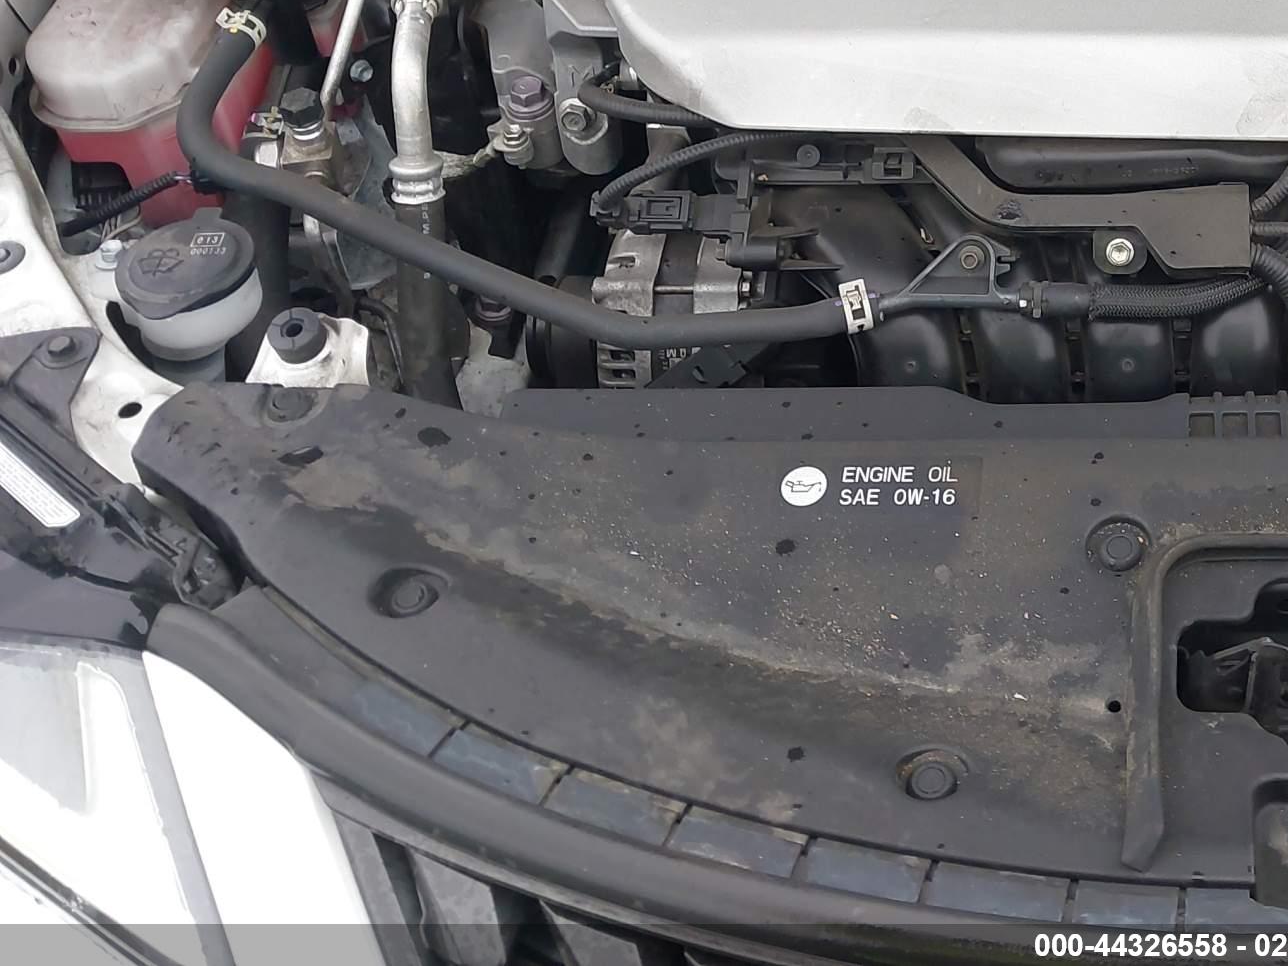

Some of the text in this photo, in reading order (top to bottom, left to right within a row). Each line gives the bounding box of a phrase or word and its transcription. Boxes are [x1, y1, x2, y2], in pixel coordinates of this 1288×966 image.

[842, 466, 958, 482] ENGINE OIL
[839, 488, 956, 506] SAE 0W-16
